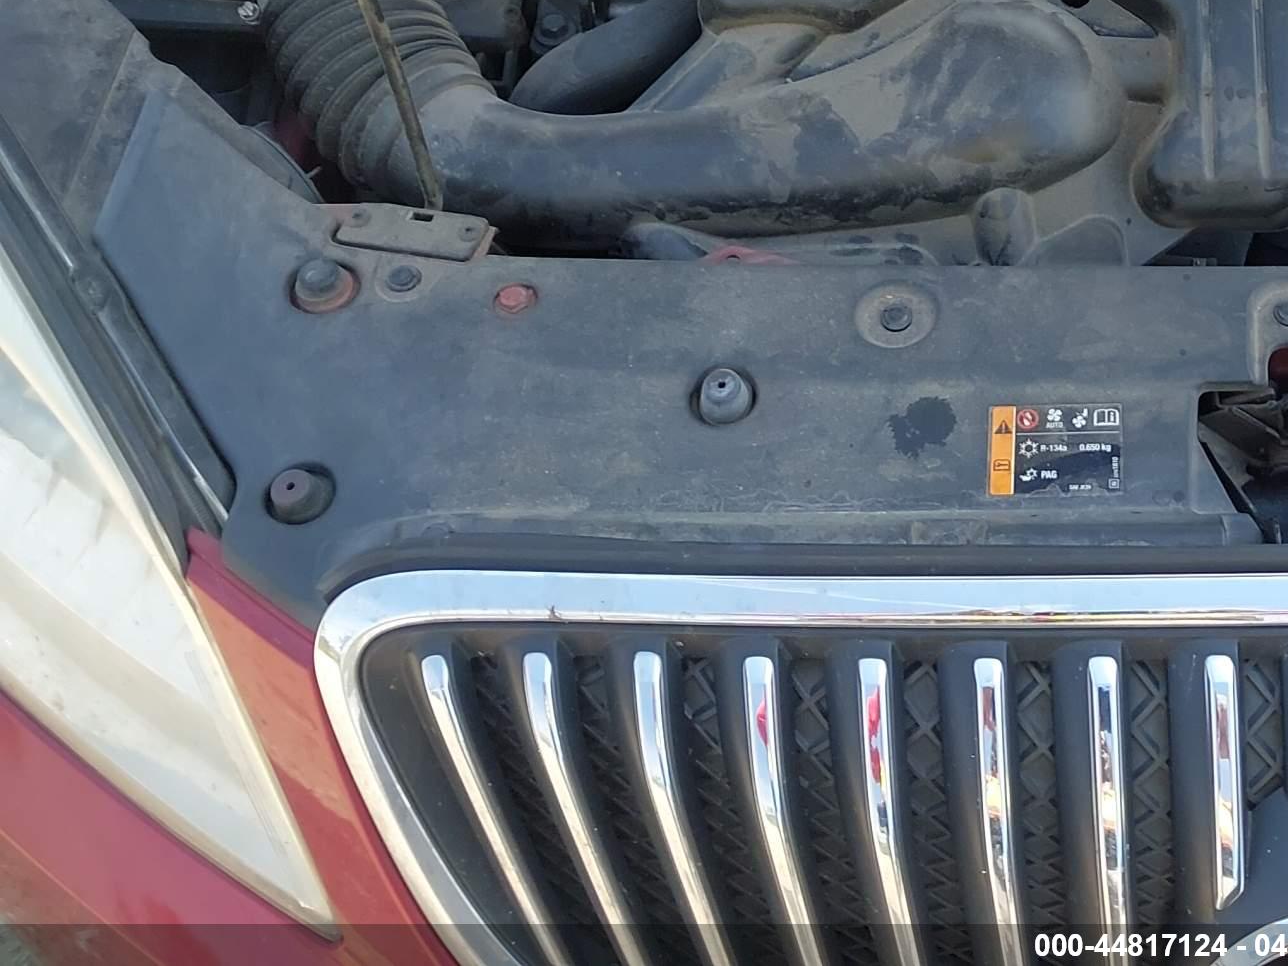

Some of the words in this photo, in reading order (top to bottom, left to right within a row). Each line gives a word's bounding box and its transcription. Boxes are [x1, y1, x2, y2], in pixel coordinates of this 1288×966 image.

[1046, 421, 1064, 429] AUTO
[1040, 444, 1068, 452] R-134a
[1079, 444, 1100, 452] 0.650
[1101, 443, 1112, 452] kg
[1041, 470, 1058, 479] PAG
